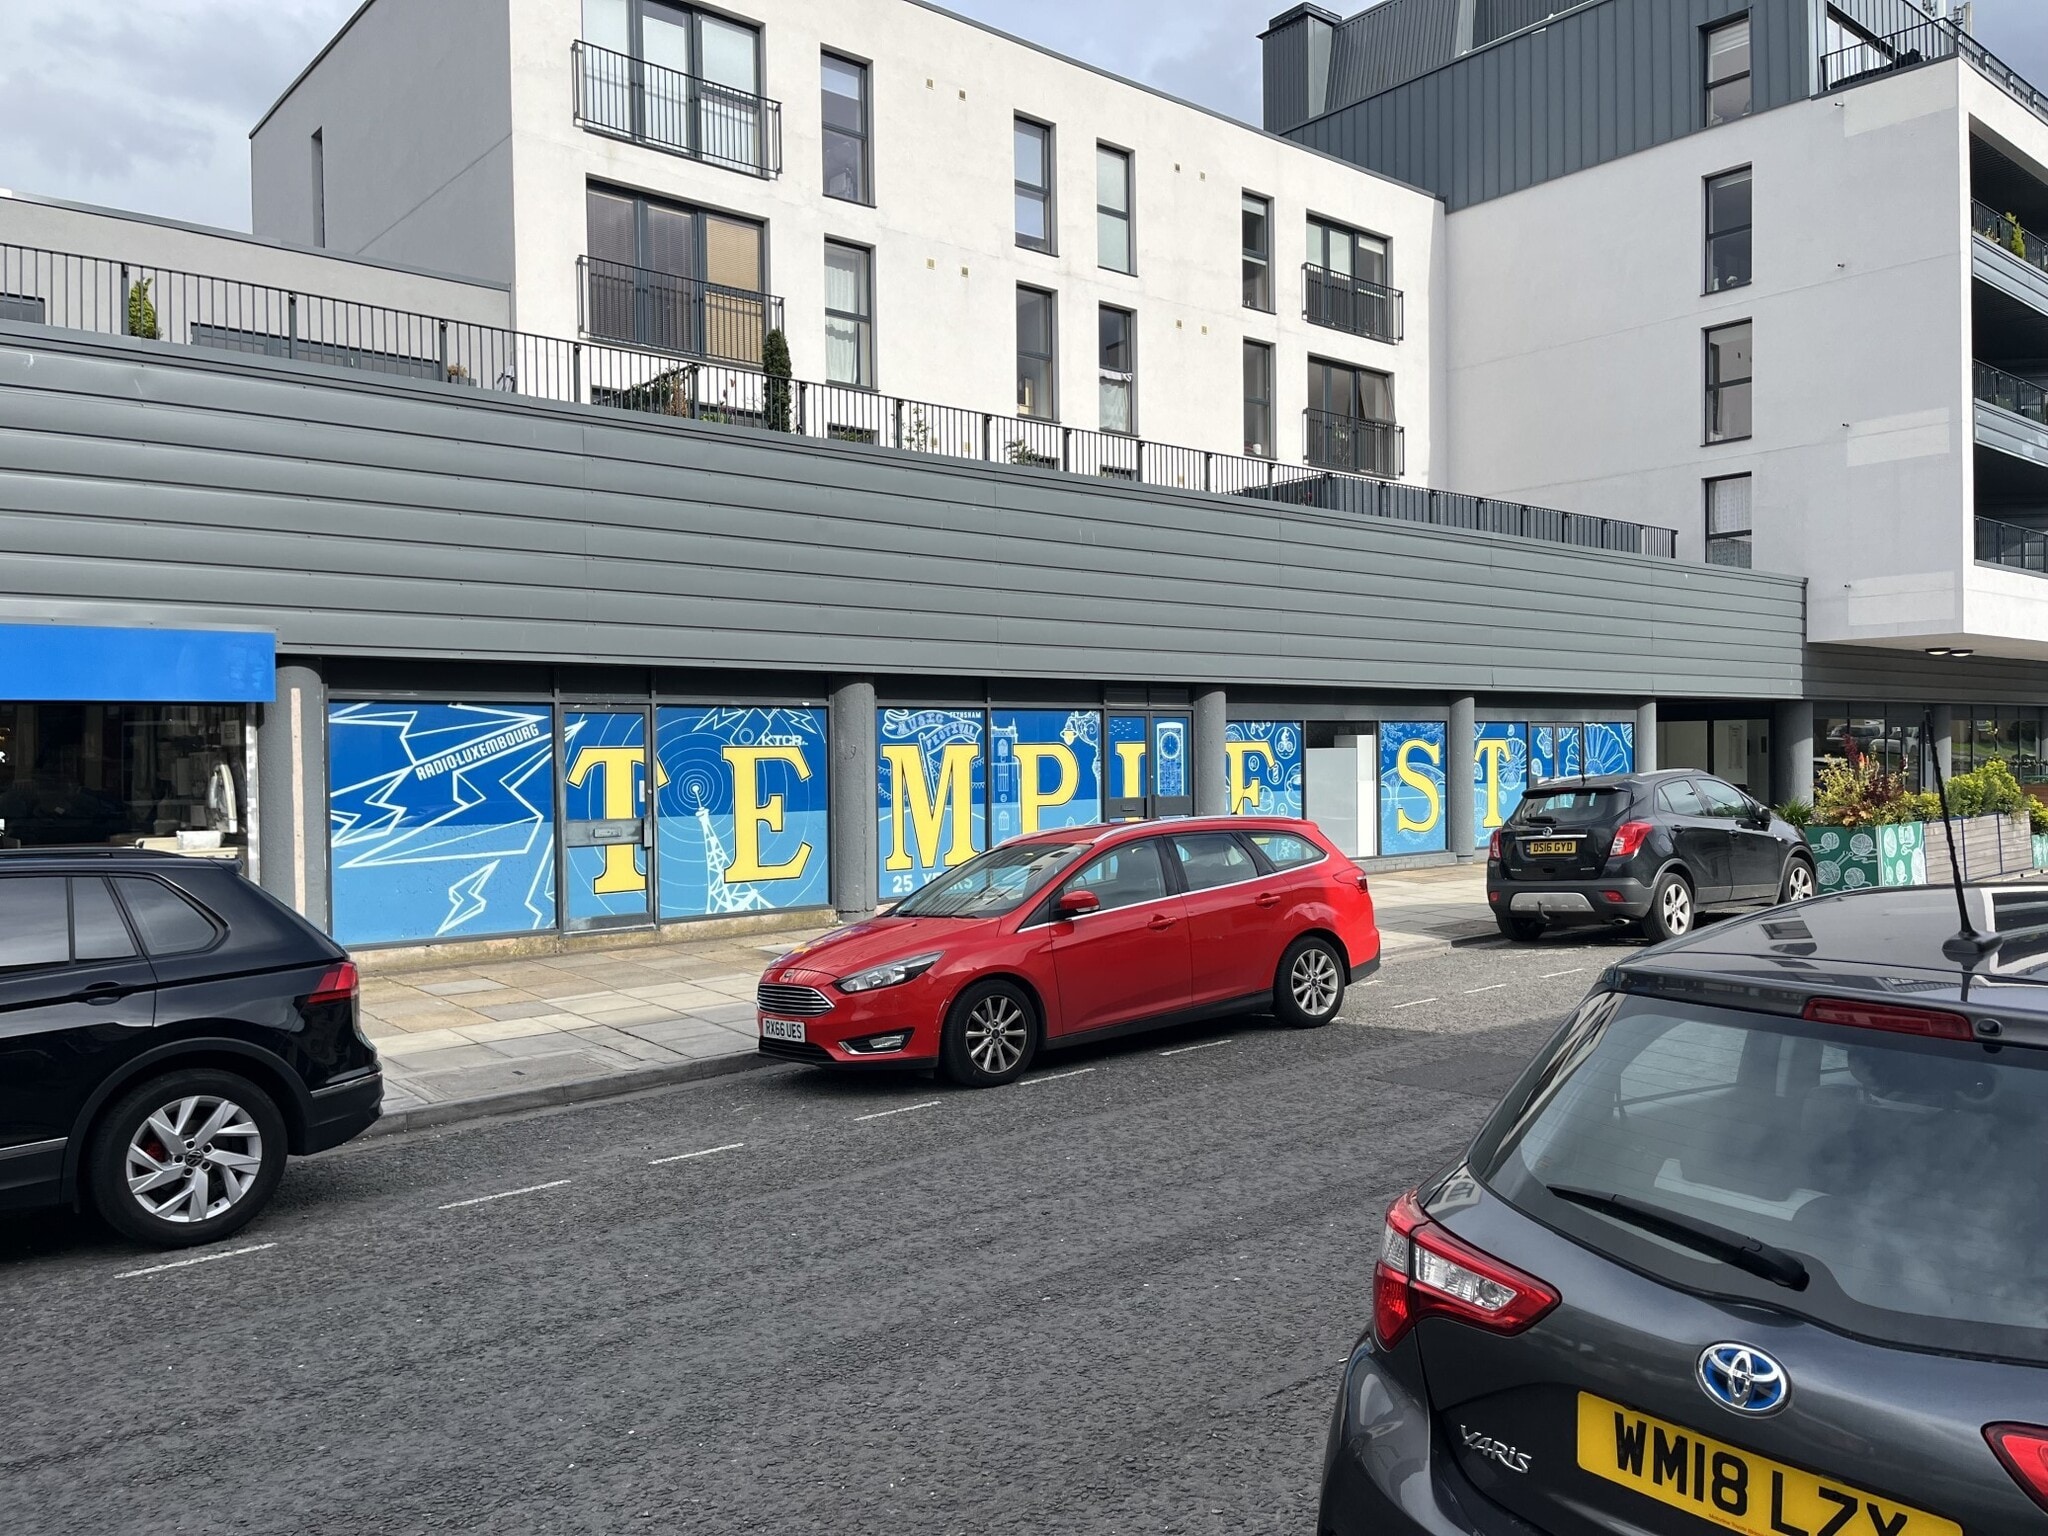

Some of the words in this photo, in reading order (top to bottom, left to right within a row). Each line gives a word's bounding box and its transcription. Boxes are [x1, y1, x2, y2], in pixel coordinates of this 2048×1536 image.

[1533, 842, 1552, 853] DS16
[1554, 841, 1573, 852] GYD
[892, 875, 913, 893] 25
[766, 1020, 785, 1037] RX66
[786, 1022, 802, 1039] UES
[1614, 1411, 1748, 1517] WM18
